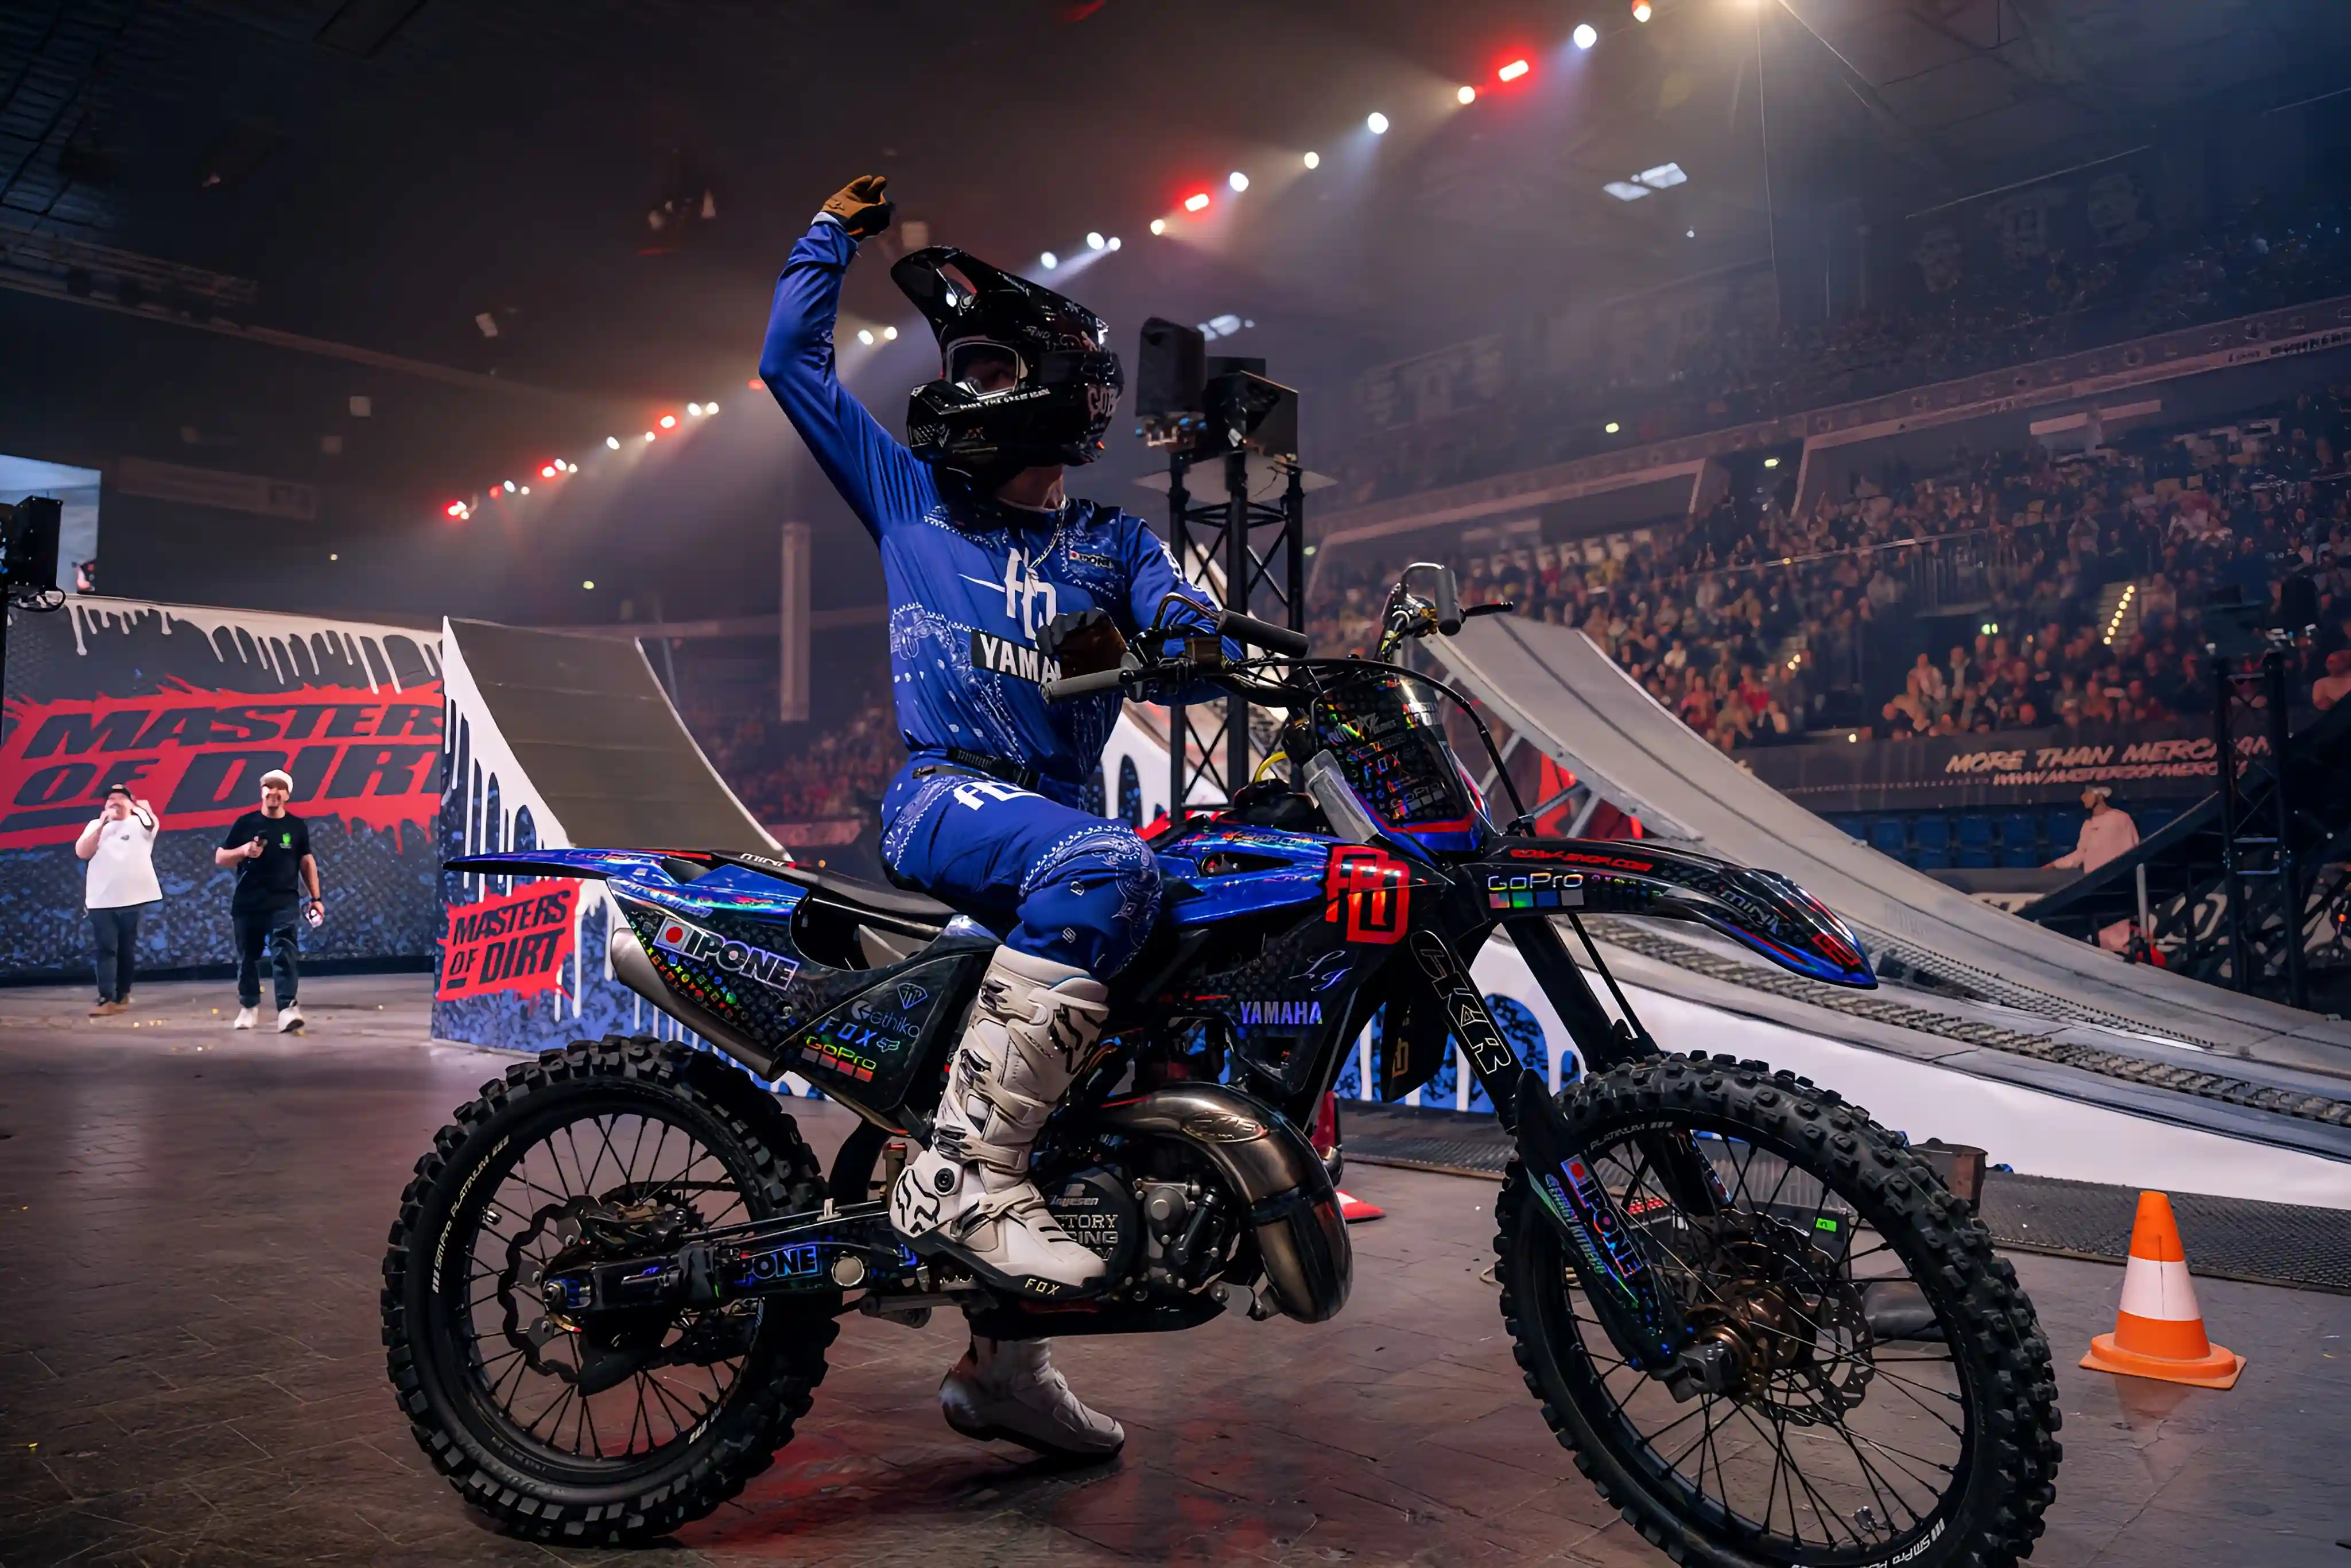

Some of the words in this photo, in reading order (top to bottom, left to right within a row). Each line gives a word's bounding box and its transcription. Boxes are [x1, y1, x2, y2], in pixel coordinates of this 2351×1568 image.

[979, 632, 1061, 684] YAMA
[1945, 750, 2026, 773] MORE
[2036, 746, 2113, 768] THAN
[13, 759, 159, 805] OF
[1488, 872, 1583, 891] GoPro
[452, 890, 572, 946] MASTERS
[449, 949, 478, 976] OF
[479, 927, 566, 987] DIRT
[1240, 1001, 1322, 1024] YAMAHA
[816, 1015, 877, 1047] FOX
[805, 1035, 876, 1070] GoPro
[1589, 1122, 1646, 1151] PLATINUM
[1025, 1278, 1060, 1296] FOX
